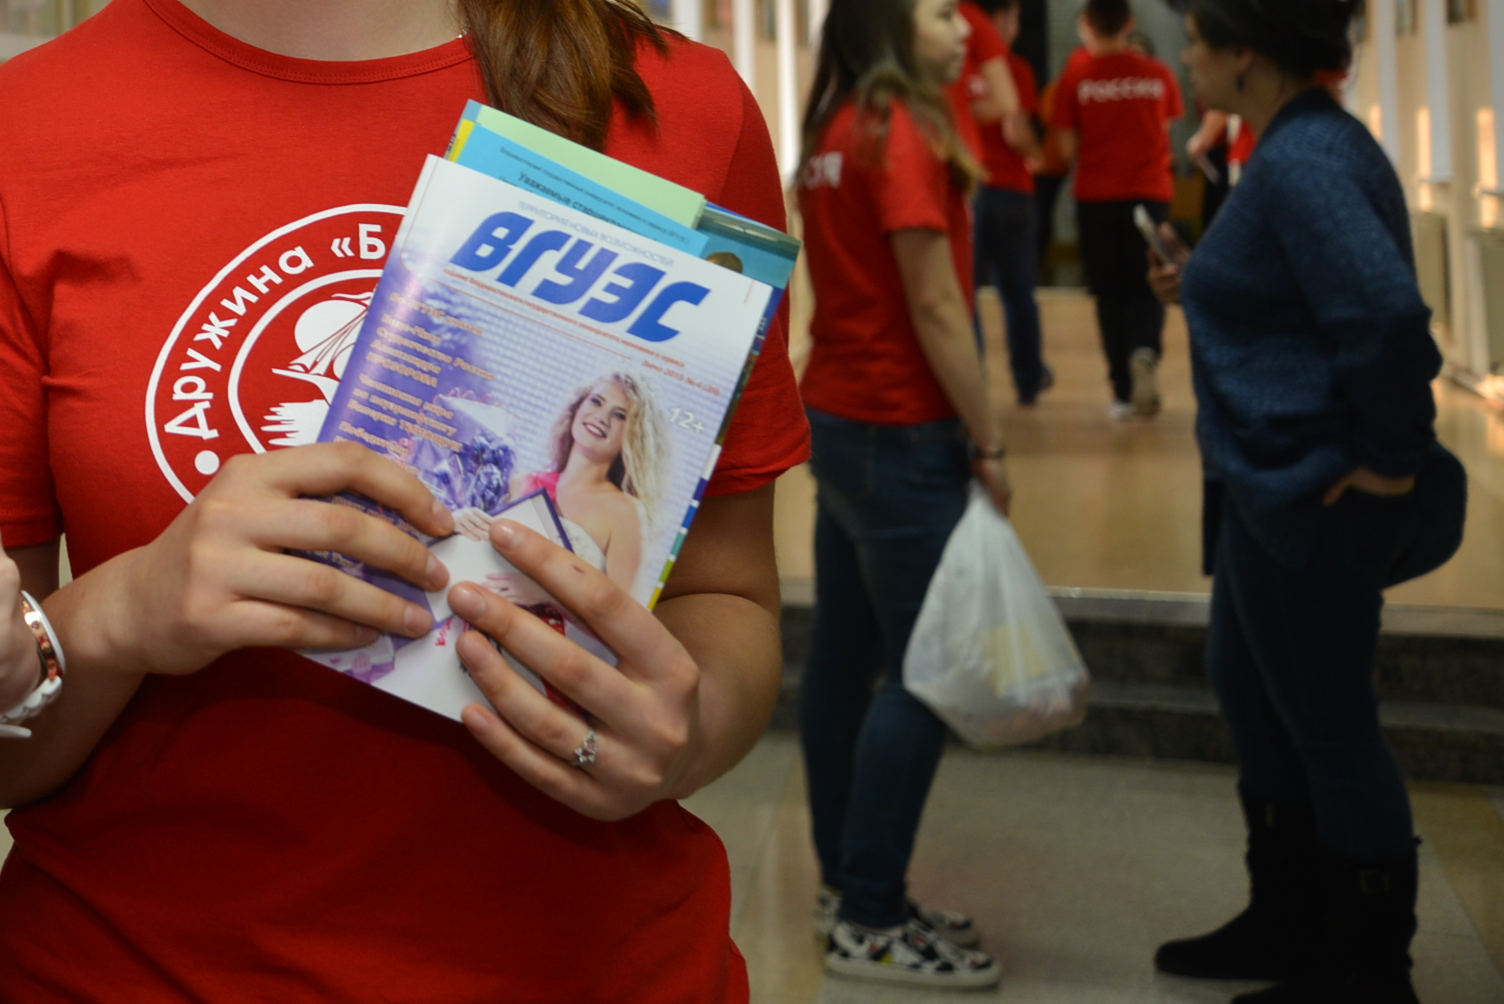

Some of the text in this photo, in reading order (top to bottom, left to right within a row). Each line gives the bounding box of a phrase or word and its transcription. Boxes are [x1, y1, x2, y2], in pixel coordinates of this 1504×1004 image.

[517, 169, 571, 207] Уважаемые
[449, 210, 712, 343] ВГУЭС
[163, 245, 315, 440] Дружина
[669, 405, 706, 434] 12+
